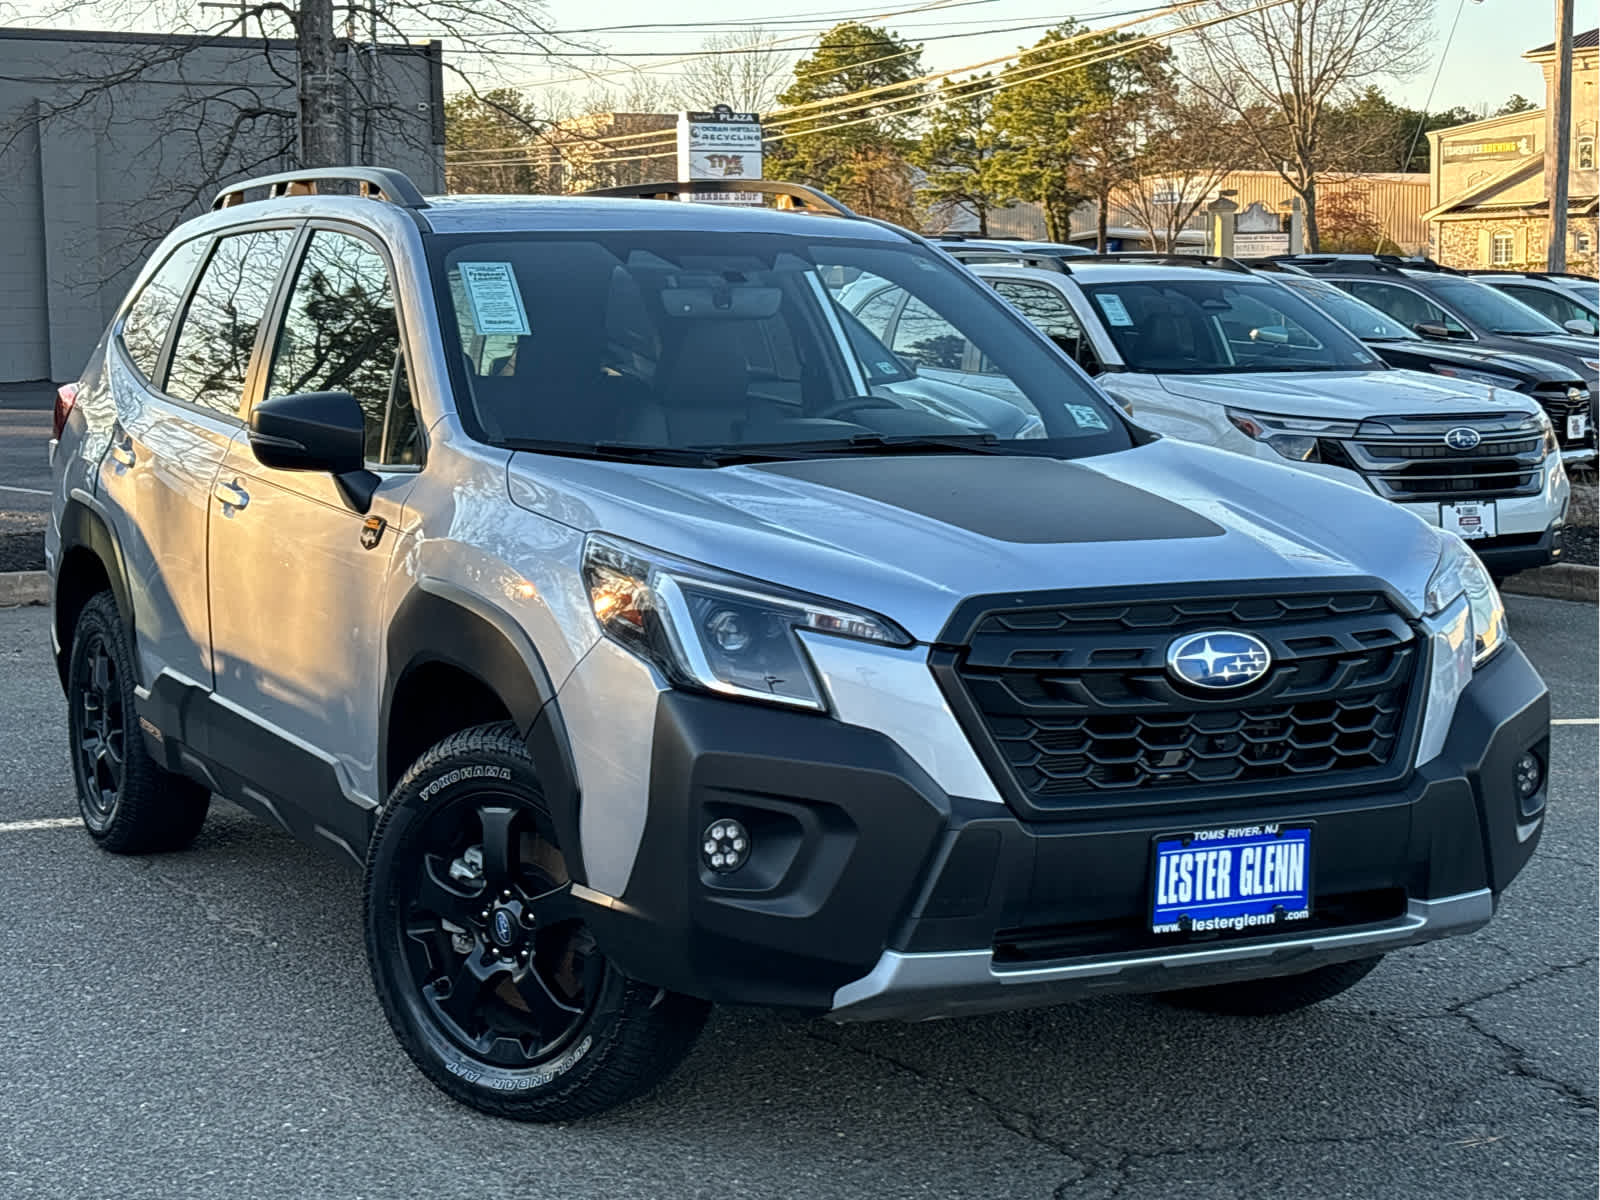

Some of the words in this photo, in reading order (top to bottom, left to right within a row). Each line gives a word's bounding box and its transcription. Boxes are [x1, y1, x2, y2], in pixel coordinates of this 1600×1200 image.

[720, 113, 754, 121] PLAZA
[419, 765, 511, 801] YOKOHAMA
[1193, 830, 1226, 841] TOMS
[1264, 824, 1280, 834] NJ
[1157, 849, 1232, 905] LESTER
[1239, 843, 1305, 897] GLENN
[445, 1062, 480, 1083] A/T
